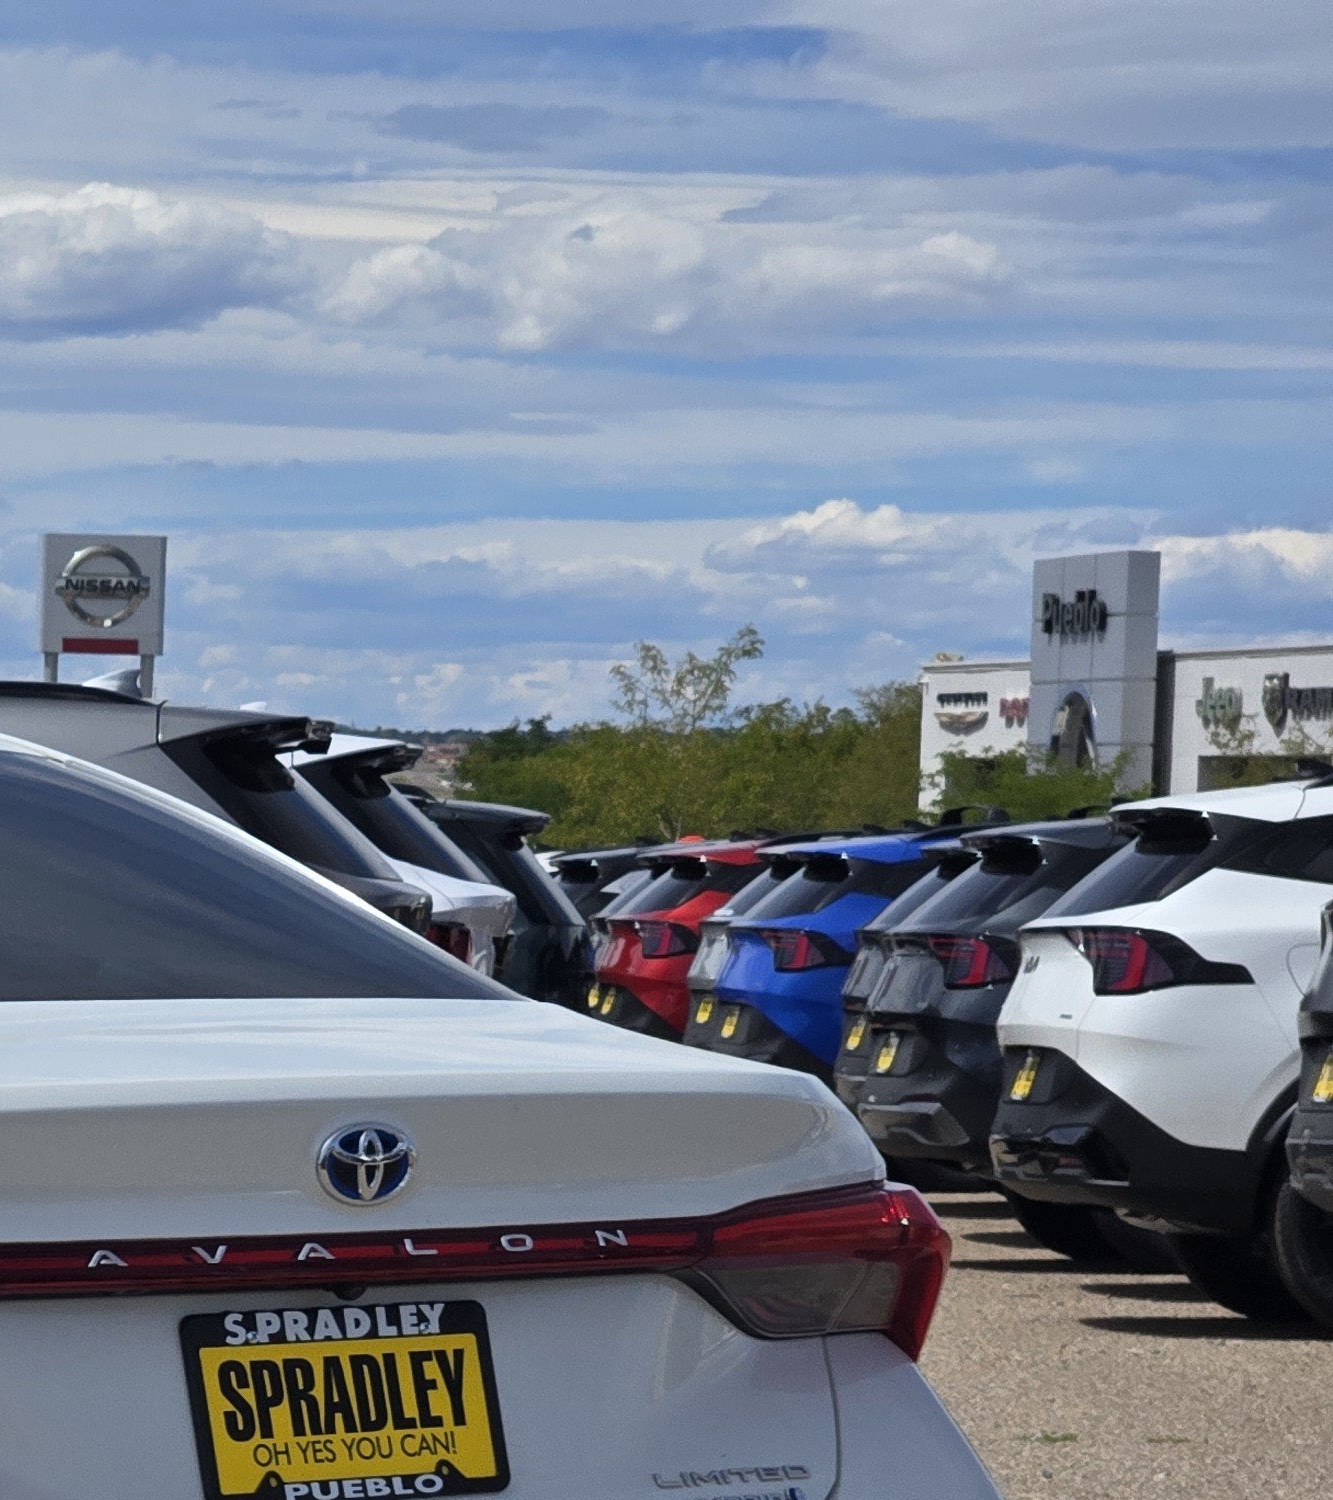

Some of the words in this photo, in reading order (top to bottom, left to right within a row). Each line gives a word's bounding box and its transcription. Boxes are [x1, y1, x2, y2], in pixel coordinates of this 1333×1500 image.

[65, 578, 140, 594] NISSAN
[1041, 589, 1107, 636] Pueblo
[87, 1229, 628, 1268] AVALON
[223, 1303, 445, 1345] SPRADLEY
[217, 1348, 467, 1442] SPRADLEY
[252, 1443, 292, 1467] OH
[296, 1440, 335, 1464] YES
[340, 1436, 393, 1460] YOU
[400, 1431, 458, 1457] CAN!
[652, 1465, 810, 1489] LIMITED
